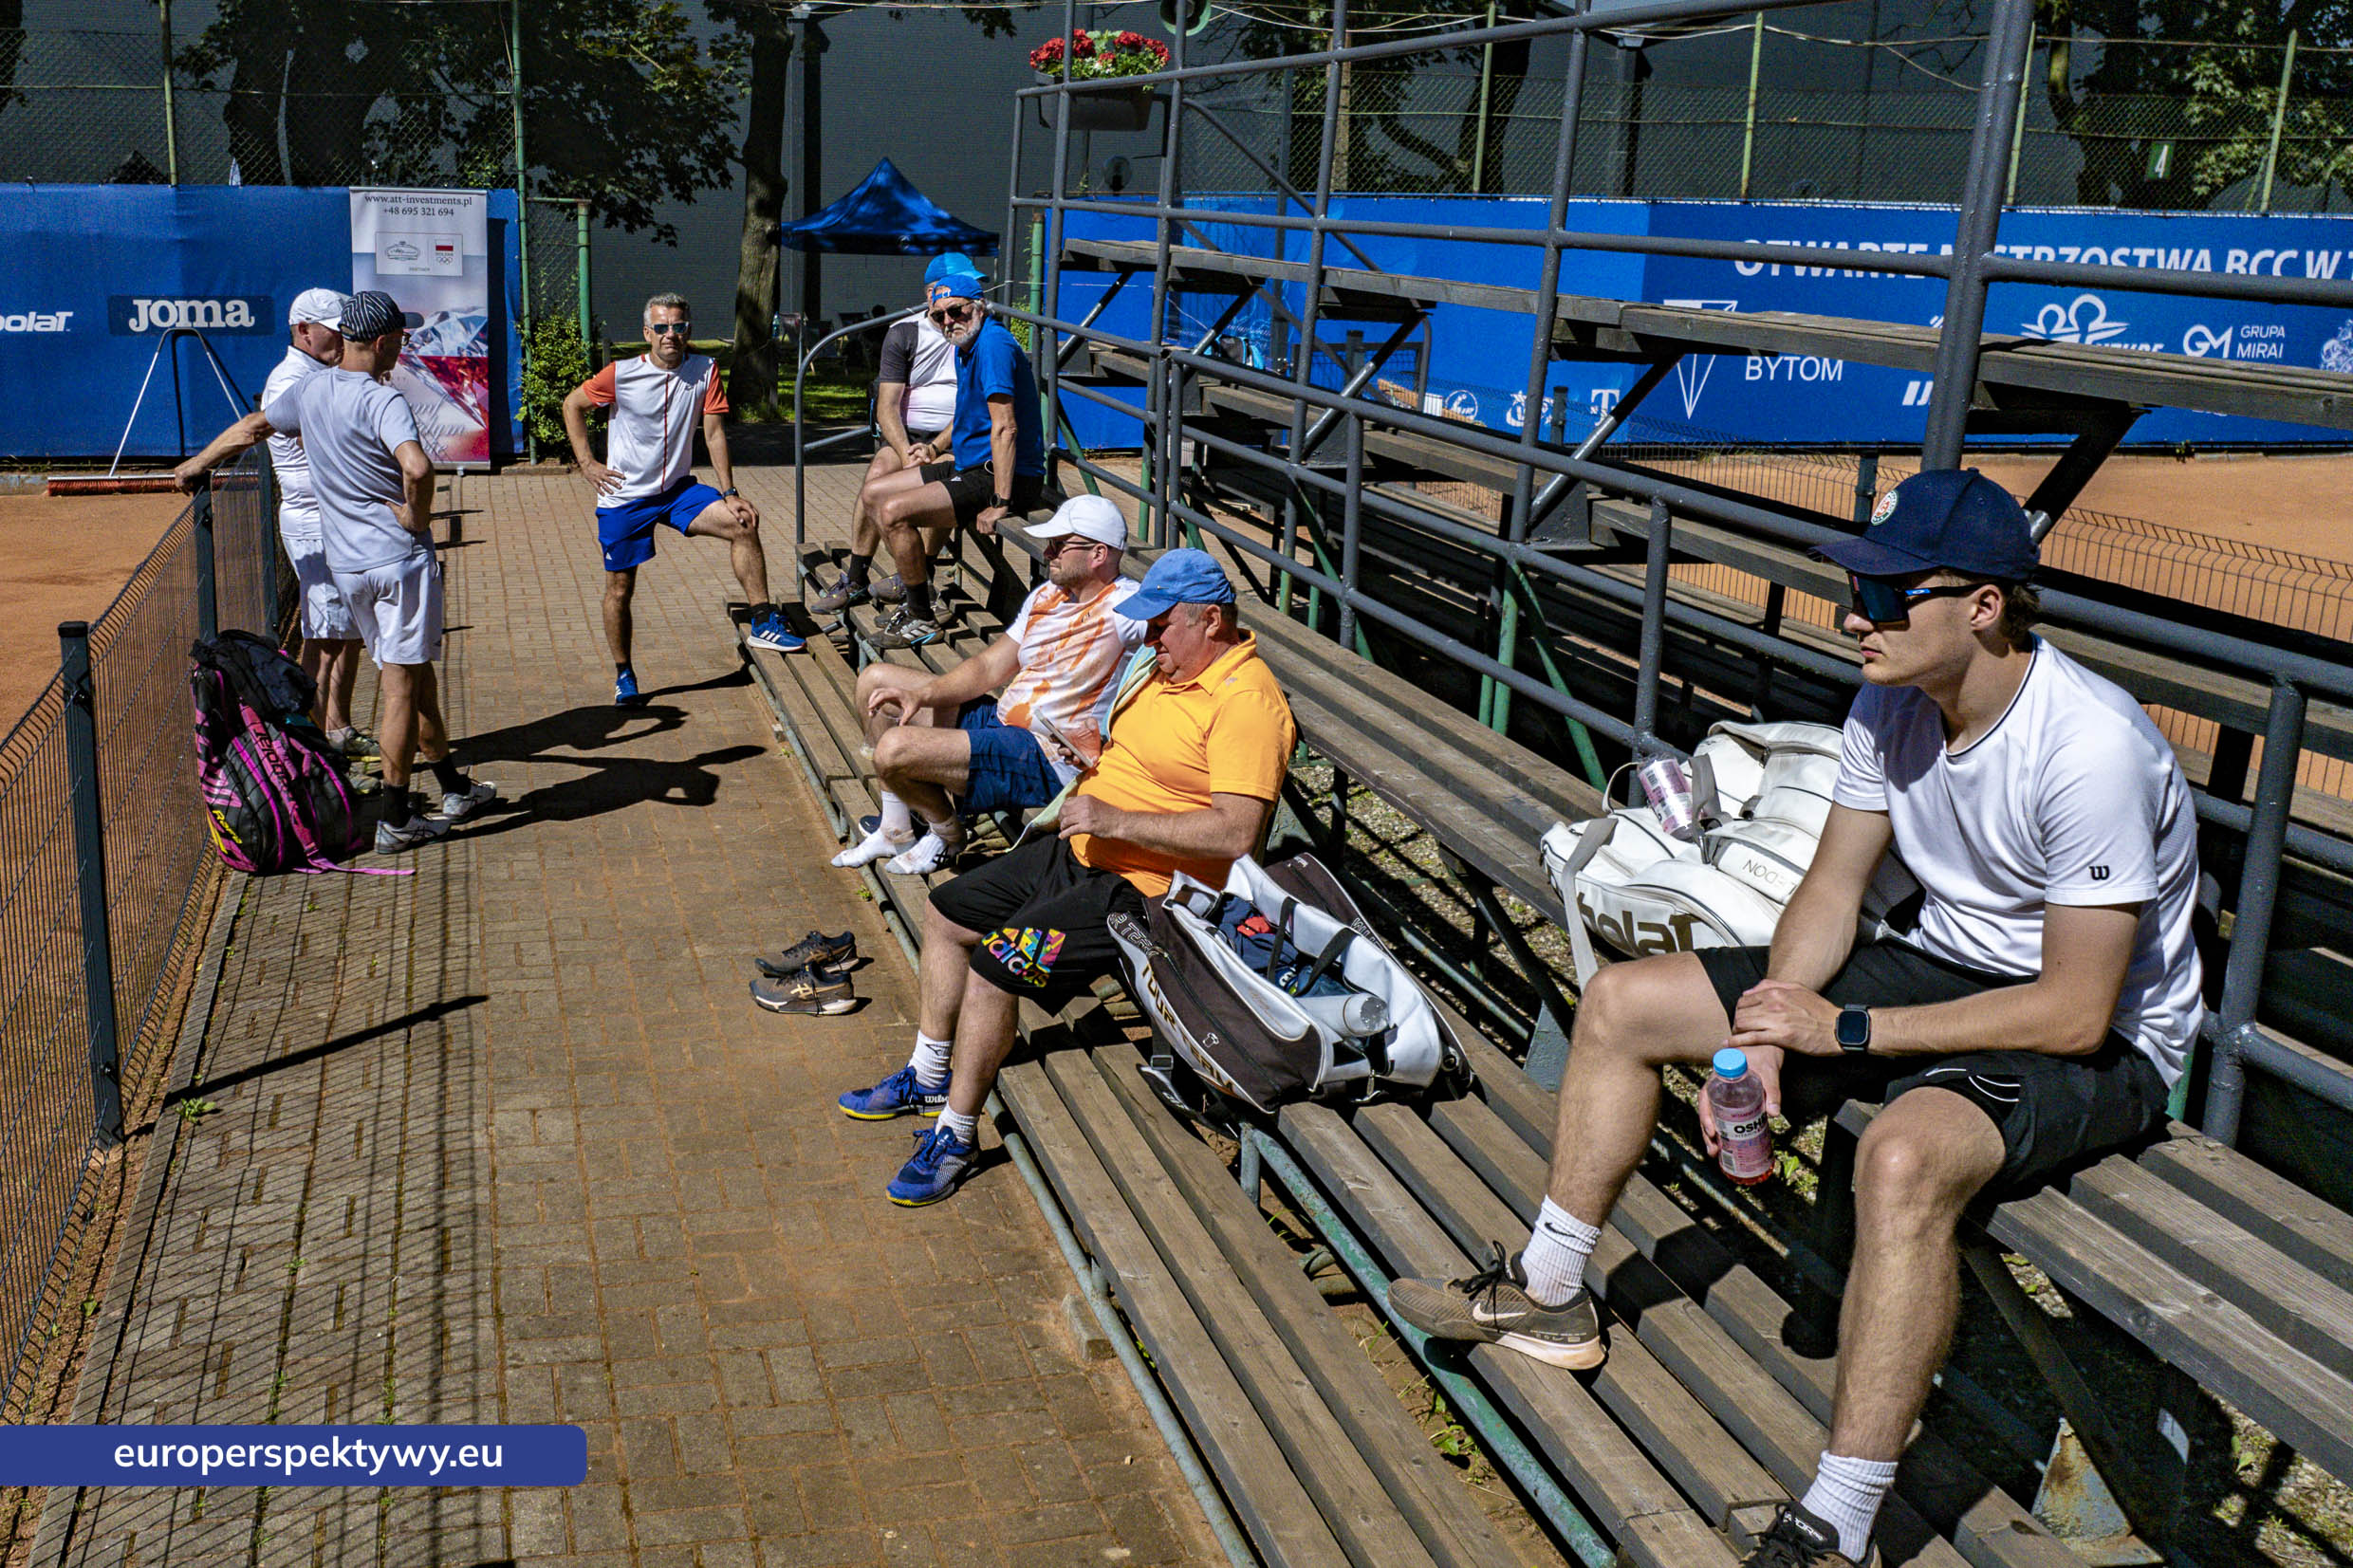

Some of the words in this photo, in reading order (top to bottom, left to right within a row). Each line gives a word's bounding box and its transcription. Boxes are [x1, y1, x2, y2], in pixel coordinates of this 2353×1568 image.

[2155, 144, 2168, 178] 4
[364, 194, 472, 207] www.att-investments.pl
[401, 207, 418, 216] 695
[420, 208, 435, 216] 321
[437, 208, 454, 216] 694
[2239, 324, 2286, 340] GRUPA
[2236, 341, 2284, 360] MIRAI
[1745, 356, 1843, 381] BYTOM
